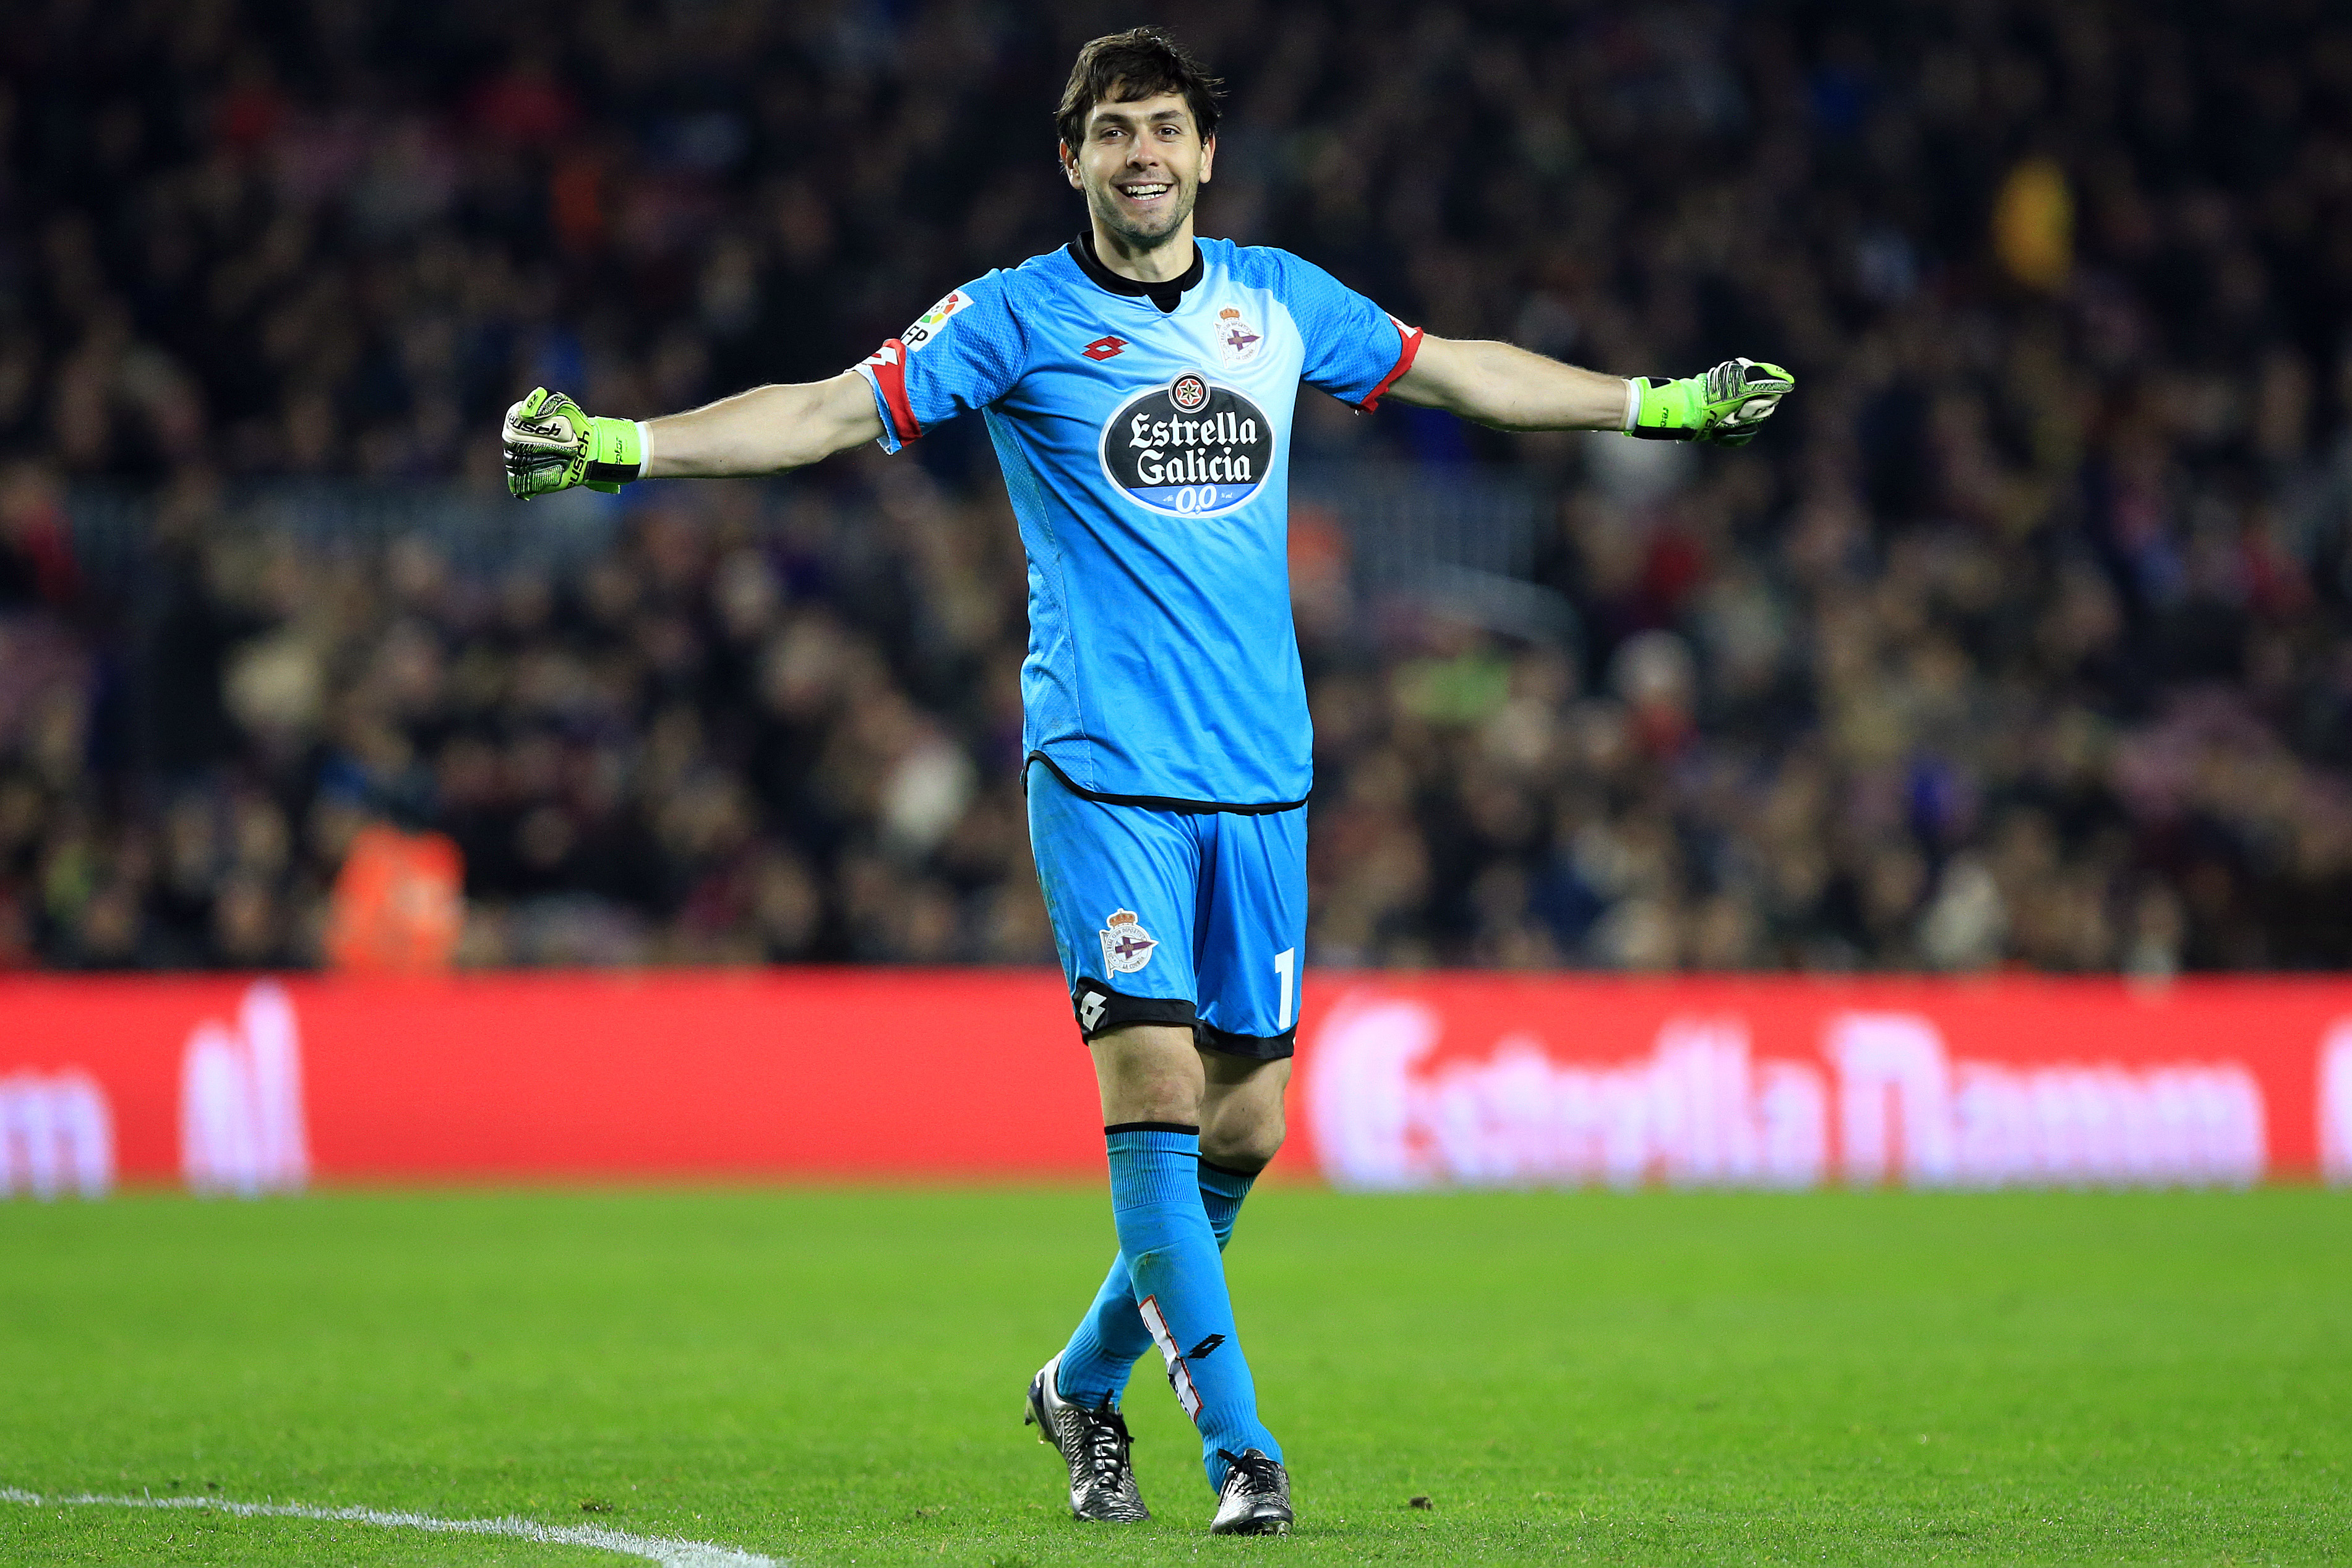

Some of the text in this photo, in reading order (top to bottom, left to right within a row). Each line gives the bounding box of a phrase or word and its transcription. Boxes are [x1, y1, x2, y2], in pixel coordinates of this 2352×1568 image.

[900, 325, 929, 346] FP
[1129, 411, 1258, 448] Estrella
[567, 431, 590, 488] eusch
[1138, 447, 1252, 484] Galicia
[1175, 485, 1217, 514] 0,0
[1274, 947, 1295, 1030] 1
